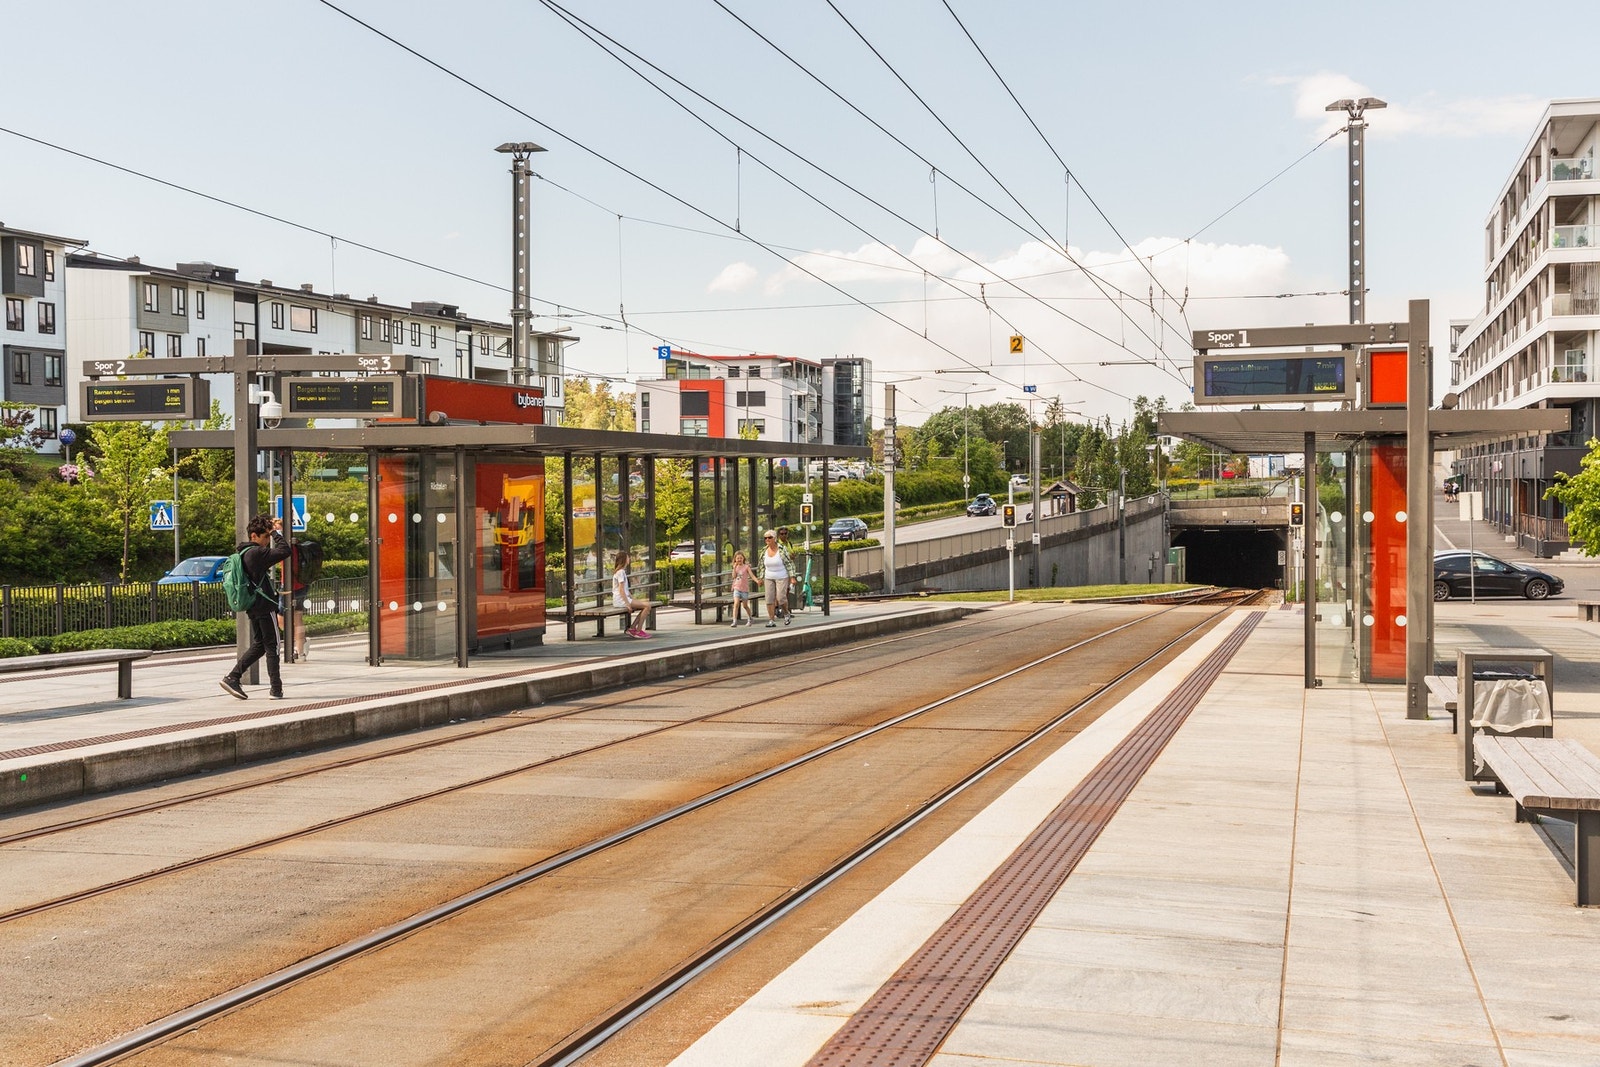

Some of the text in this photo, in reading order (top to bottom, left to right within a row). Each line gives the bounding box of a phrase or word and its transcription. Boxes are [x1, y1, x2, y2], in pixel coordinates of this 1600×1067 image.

[1012, 338, 1021, 351] 2
[1208, 330, 1251, 347] Spor 1
[661, 348, 668, 357] S
[94, 361, 126, 375] Spor 2
[358, 356, 392, 370] Spor 3
[518, 392, 545, 408] bybanen
